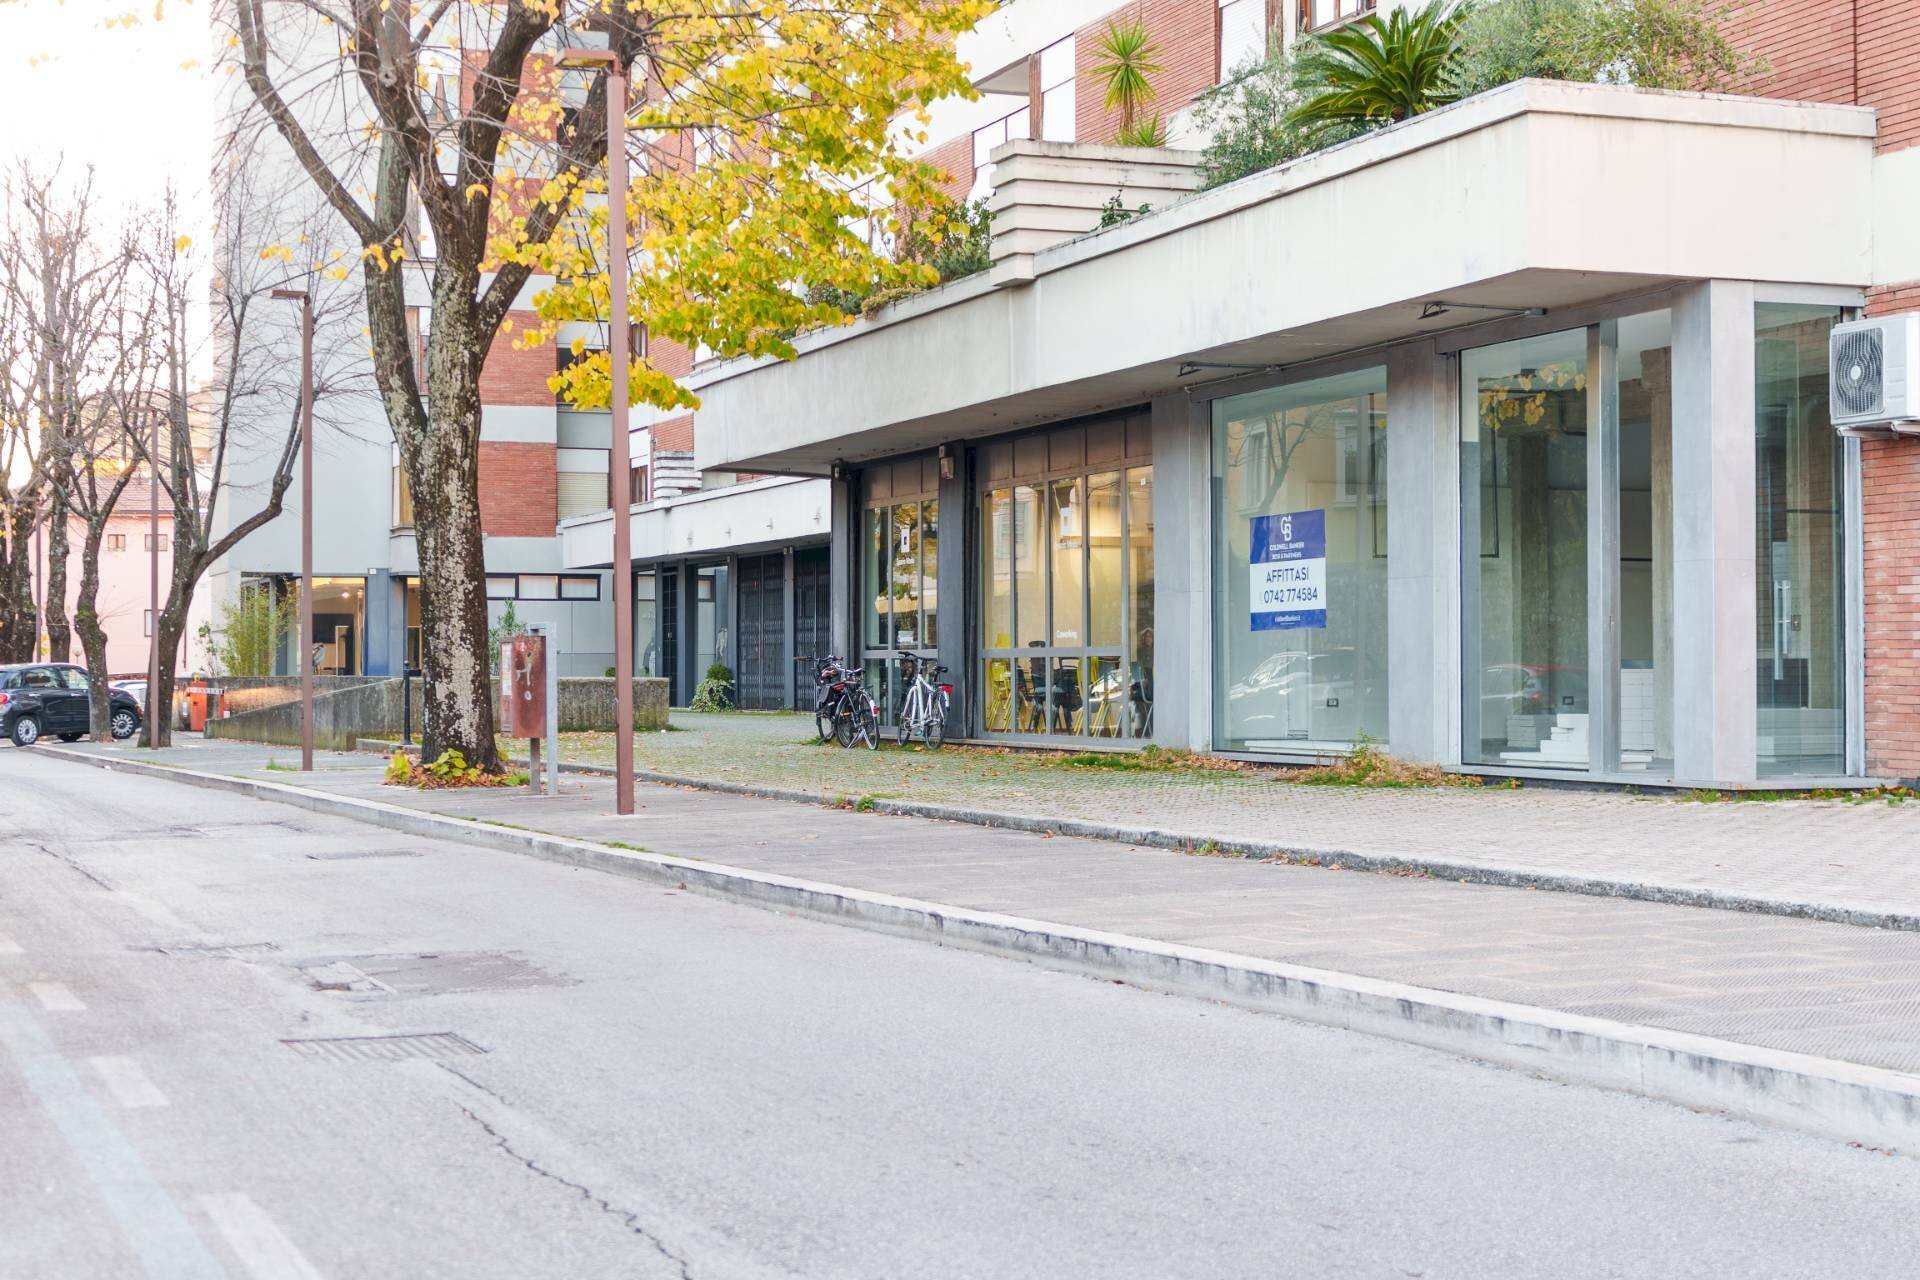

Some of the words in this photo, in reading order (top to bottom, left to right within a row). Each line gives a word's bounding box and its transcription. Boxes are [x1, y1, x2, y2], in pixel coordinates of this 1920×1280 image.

[1266, 566, 1310, 583] AFFITTASI
[1263, 589, 1285, 604] 0742
[1286, 586, 1318, 602] 774584
